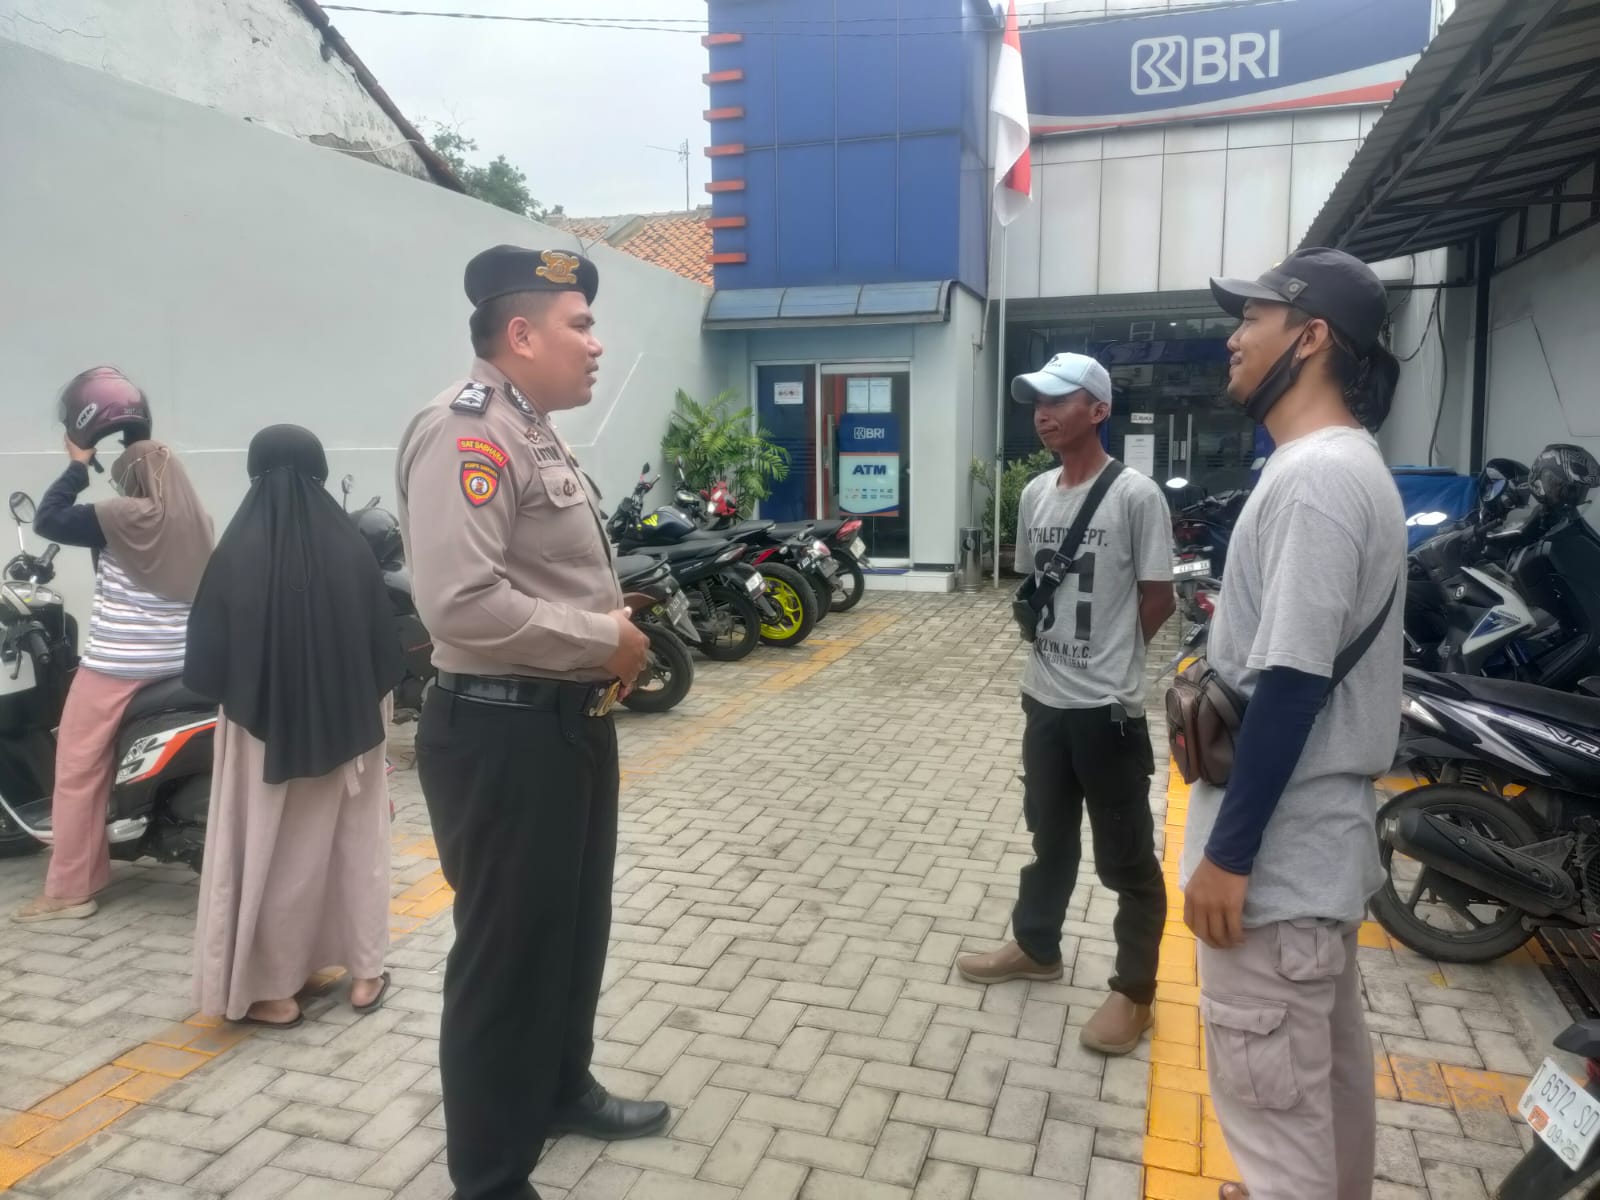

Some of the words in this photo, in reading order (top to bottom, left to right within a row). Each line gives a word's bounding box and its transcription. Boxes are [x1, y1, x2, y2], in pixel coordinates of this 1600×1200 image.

[1192, 29, 1280, 86] BRI
[865, 427, 885, 439] BRI
[852, 464, 887, 476] ATM
[1028, 526, 1071, 544] ATHLETI
[1082, 528, 1108, 547] EPT.
[1546, 726, 1600, 756] VA
[1540, 1073, 1577, 1117] 6572
